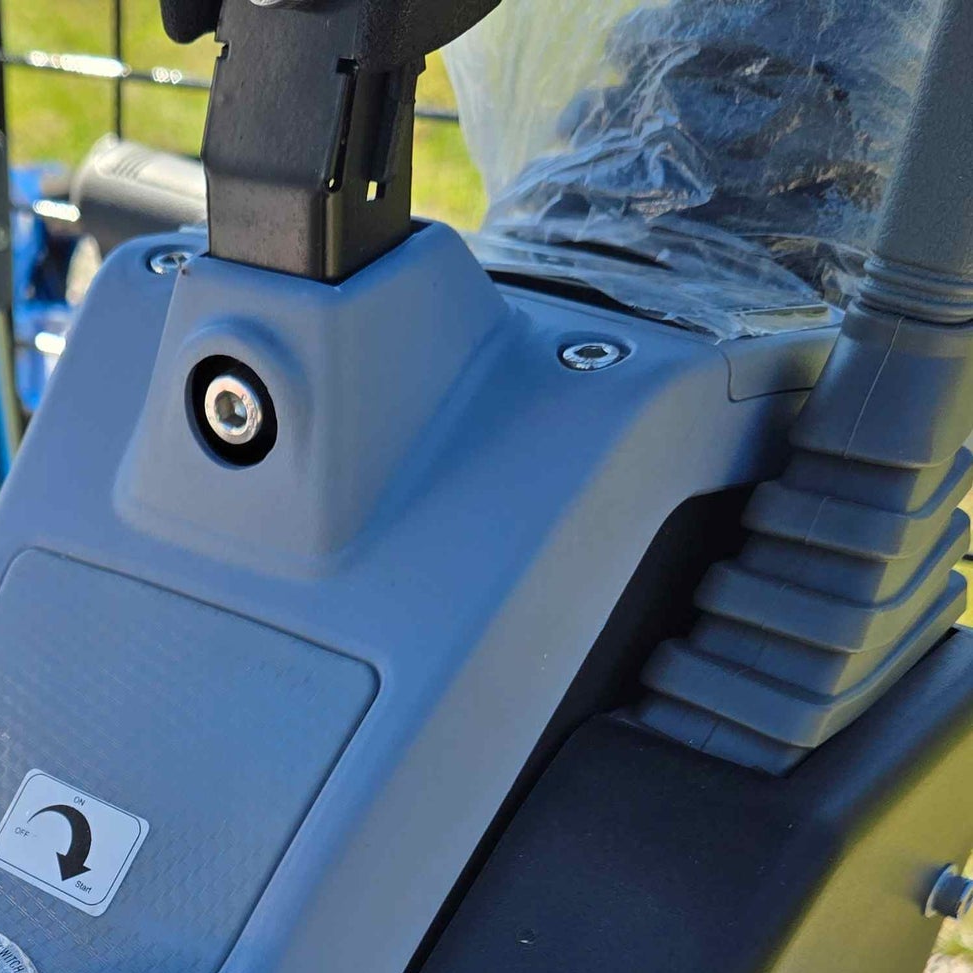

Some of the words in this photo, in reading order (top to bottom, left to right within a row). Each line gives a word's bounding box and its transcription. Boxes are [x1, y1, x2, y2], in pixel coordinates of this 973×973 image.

[73, 796, 86, 807] ON
[14, 827, 30, 838] OFF
[75, 880, 93, 893] Start
